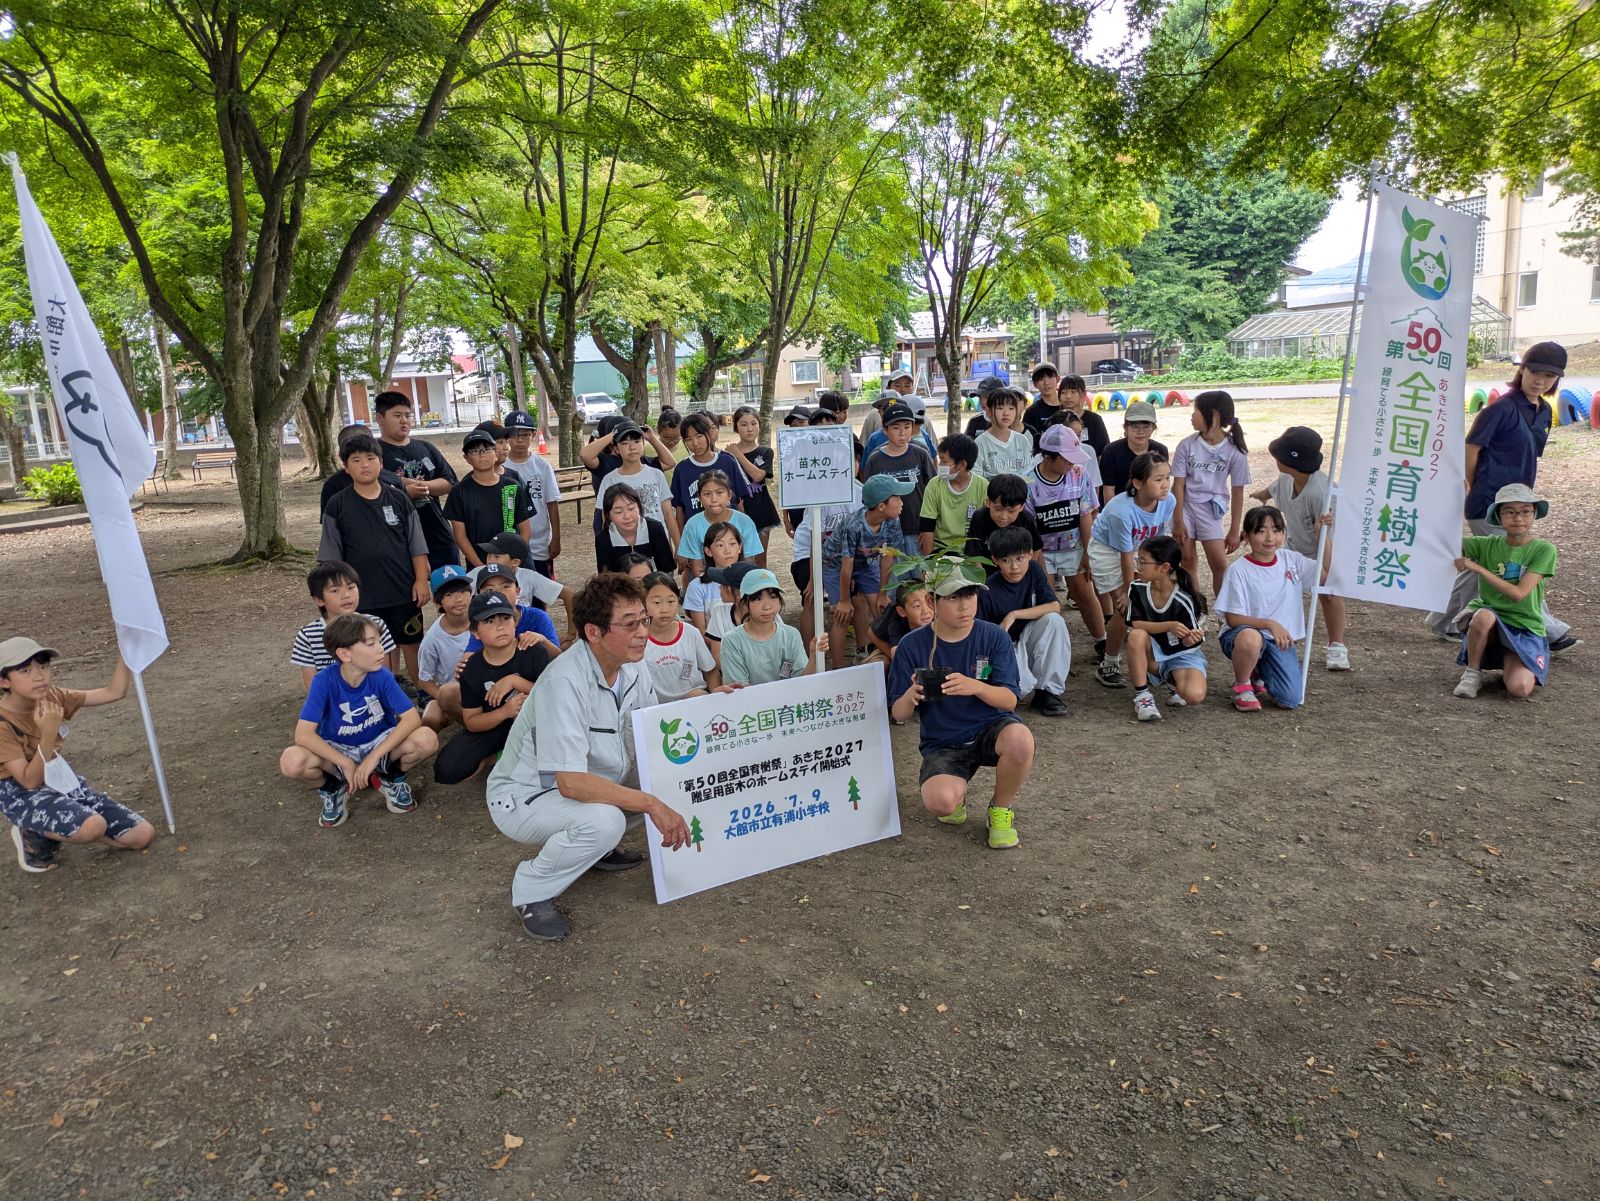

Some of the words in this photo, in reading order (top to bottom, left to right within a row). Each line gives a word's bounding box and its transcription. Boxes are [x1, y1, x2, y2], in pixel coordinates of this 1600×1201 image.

[1385, 320, 1452, 371] 第50回
[1429, 378, 1449, 480] あきた2027
[784, 467, 850, 482] ホームステイ
[799, 456, 832, 469] 苗木の
[1372, 371, 1436, 588] 全国育樹祭
[1356, 467, 1380, 585] 未来へつながる大きな希望
[835, 690, 865, 704] あきた
[837, 701, 865, 715] 2027
[691, 754, 851, 804] 贈呈用苗木のホームステイ開始式
[724, 801, 830, 840] 大館市立有浦小学校
[730, 801, 775, 824] 2026
